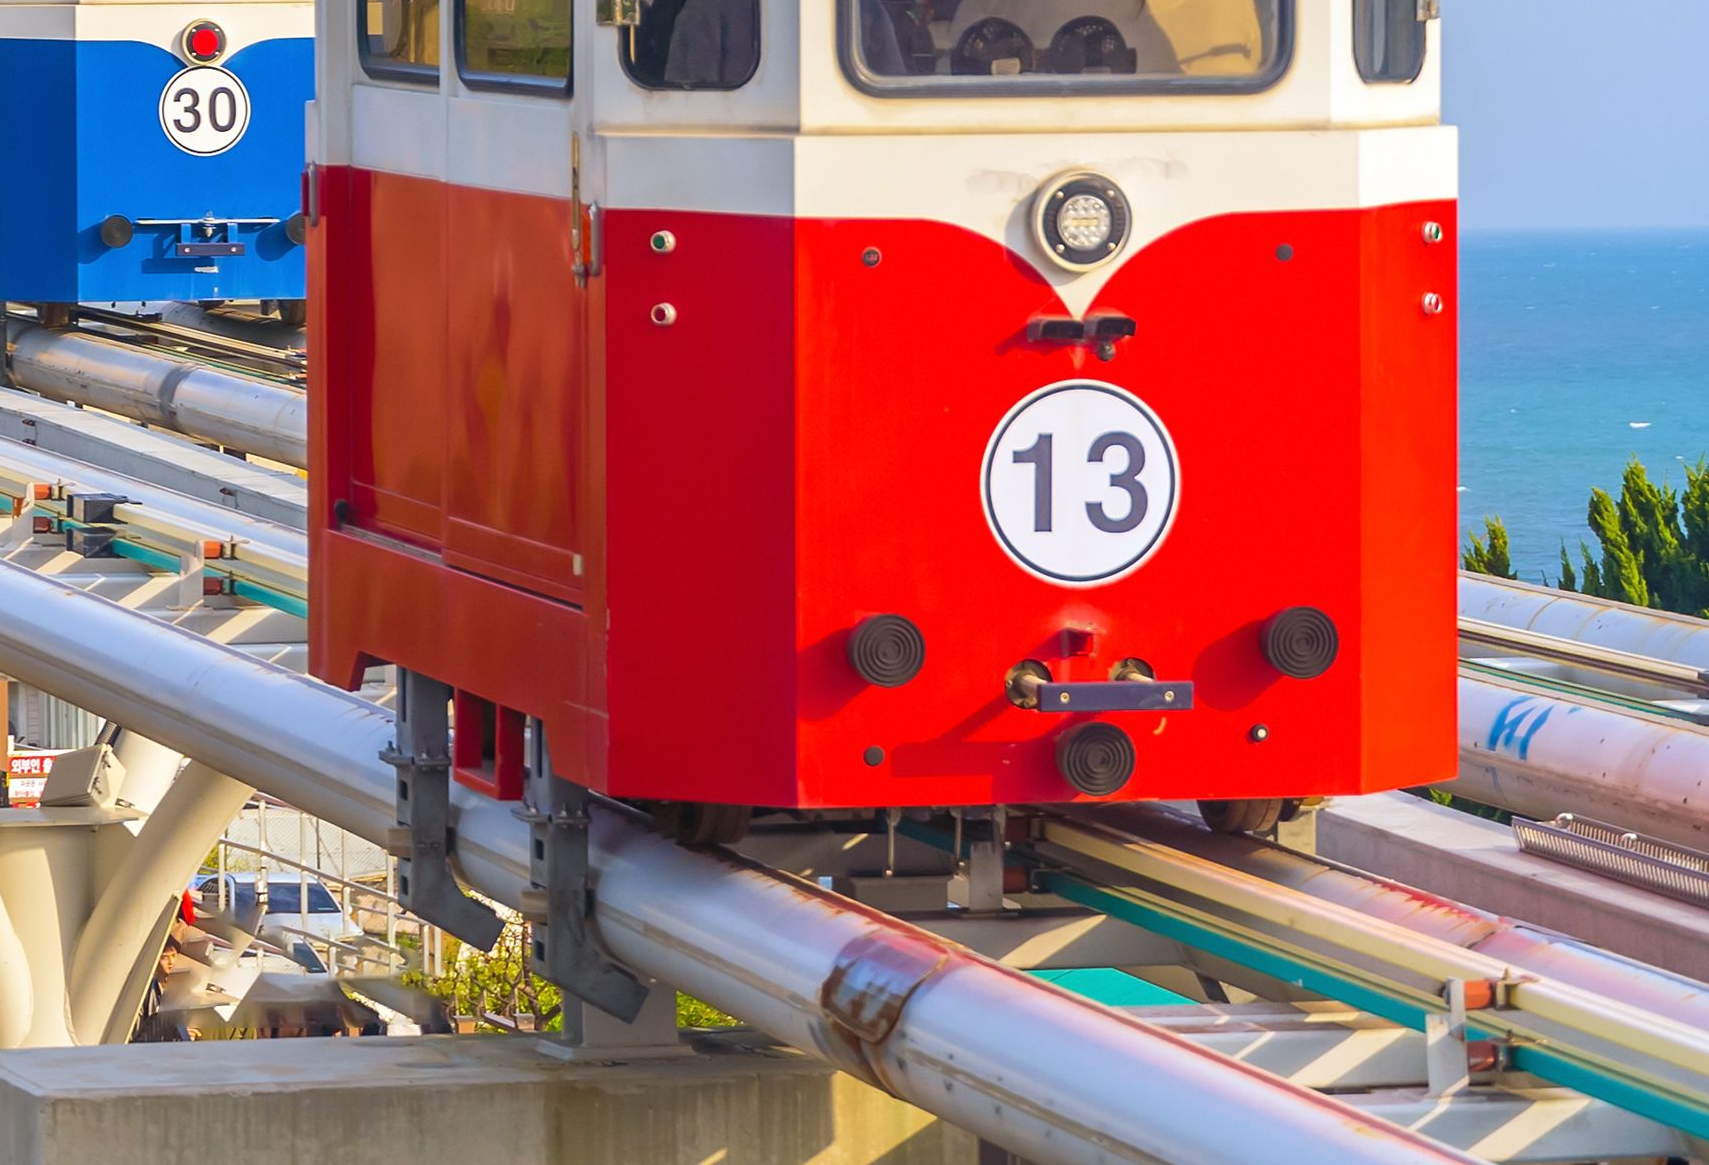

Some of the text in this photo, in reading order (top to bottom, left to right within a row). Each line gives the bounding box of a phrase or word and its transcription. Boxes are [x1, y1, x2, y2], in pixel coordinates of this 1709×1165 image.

[173, 86, 236, 133] 30
[1012, 431, 1149, 534] 13
[11, 759, 41, 774] 외부인
